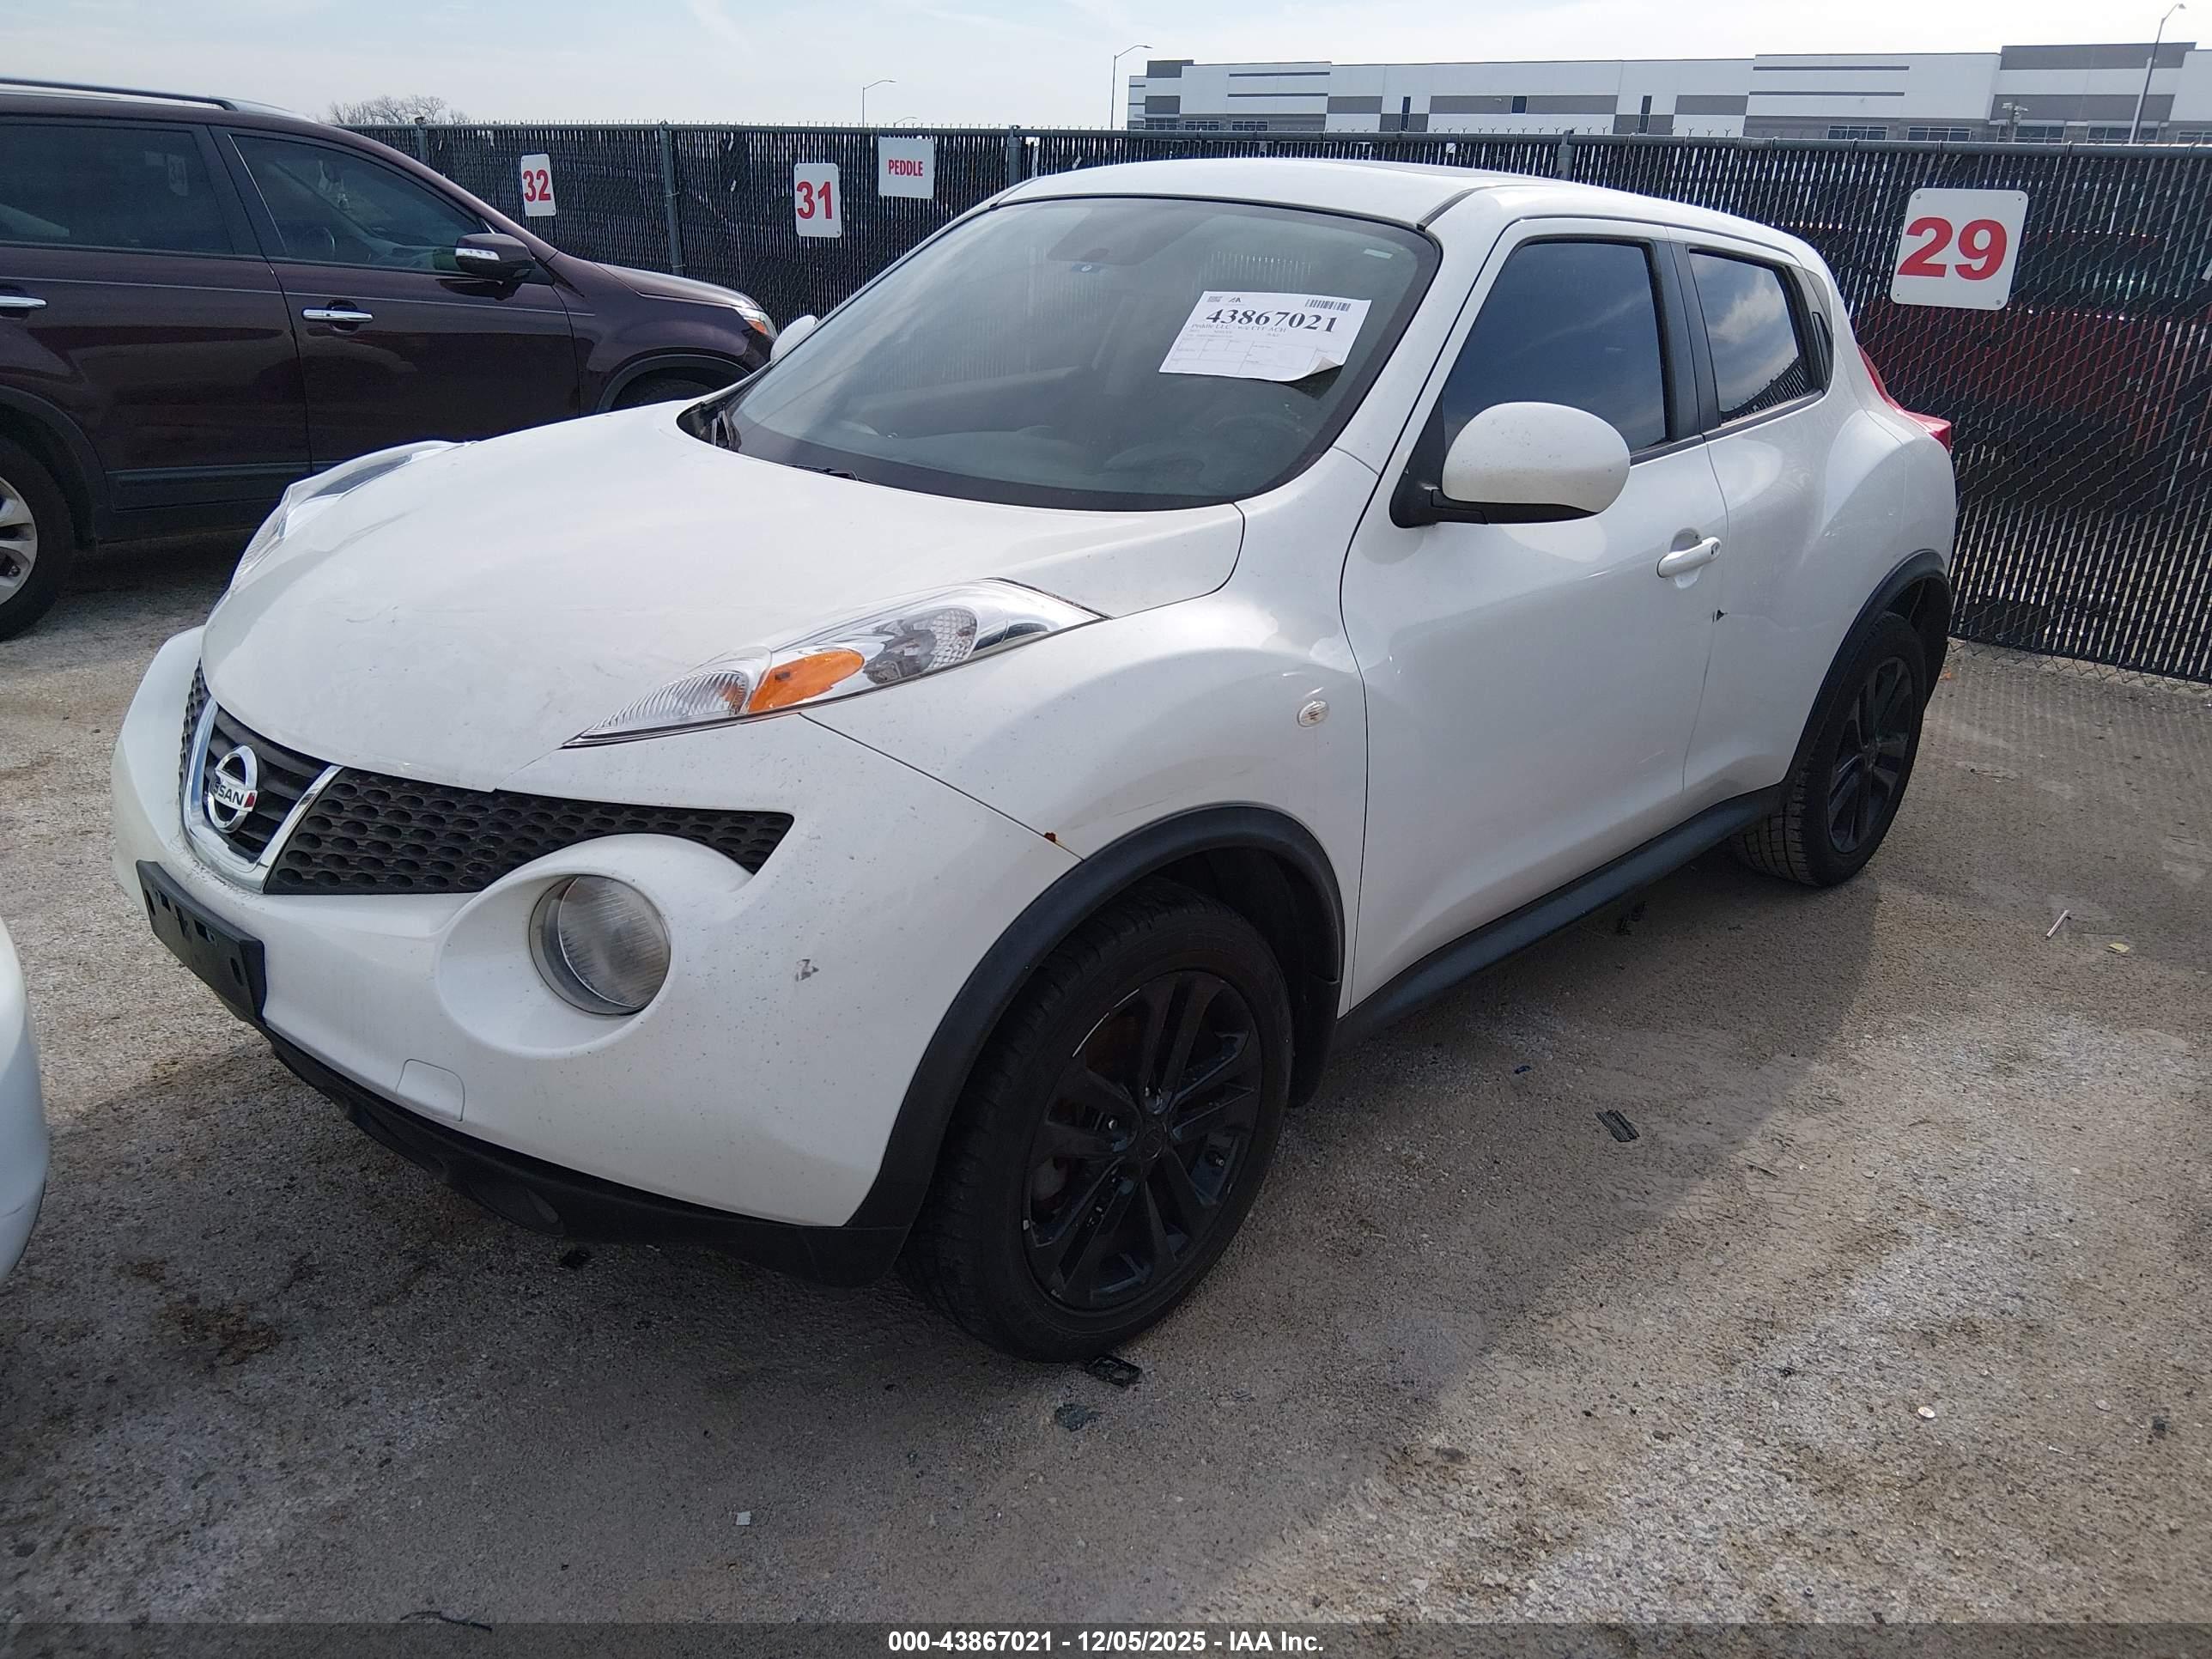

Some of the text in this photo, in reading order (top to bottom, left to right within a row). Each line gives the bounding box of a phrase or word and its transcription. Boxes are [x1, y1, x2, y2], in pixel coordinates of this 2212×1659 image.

[889, 159, 923, 177] PEDDLE
[522, 169, 551, 202] 32
[796, 181, 833, 220] 31
[1897, 216, 2008, 280] 29
[1206, 308, 1338, 333] 43867021
